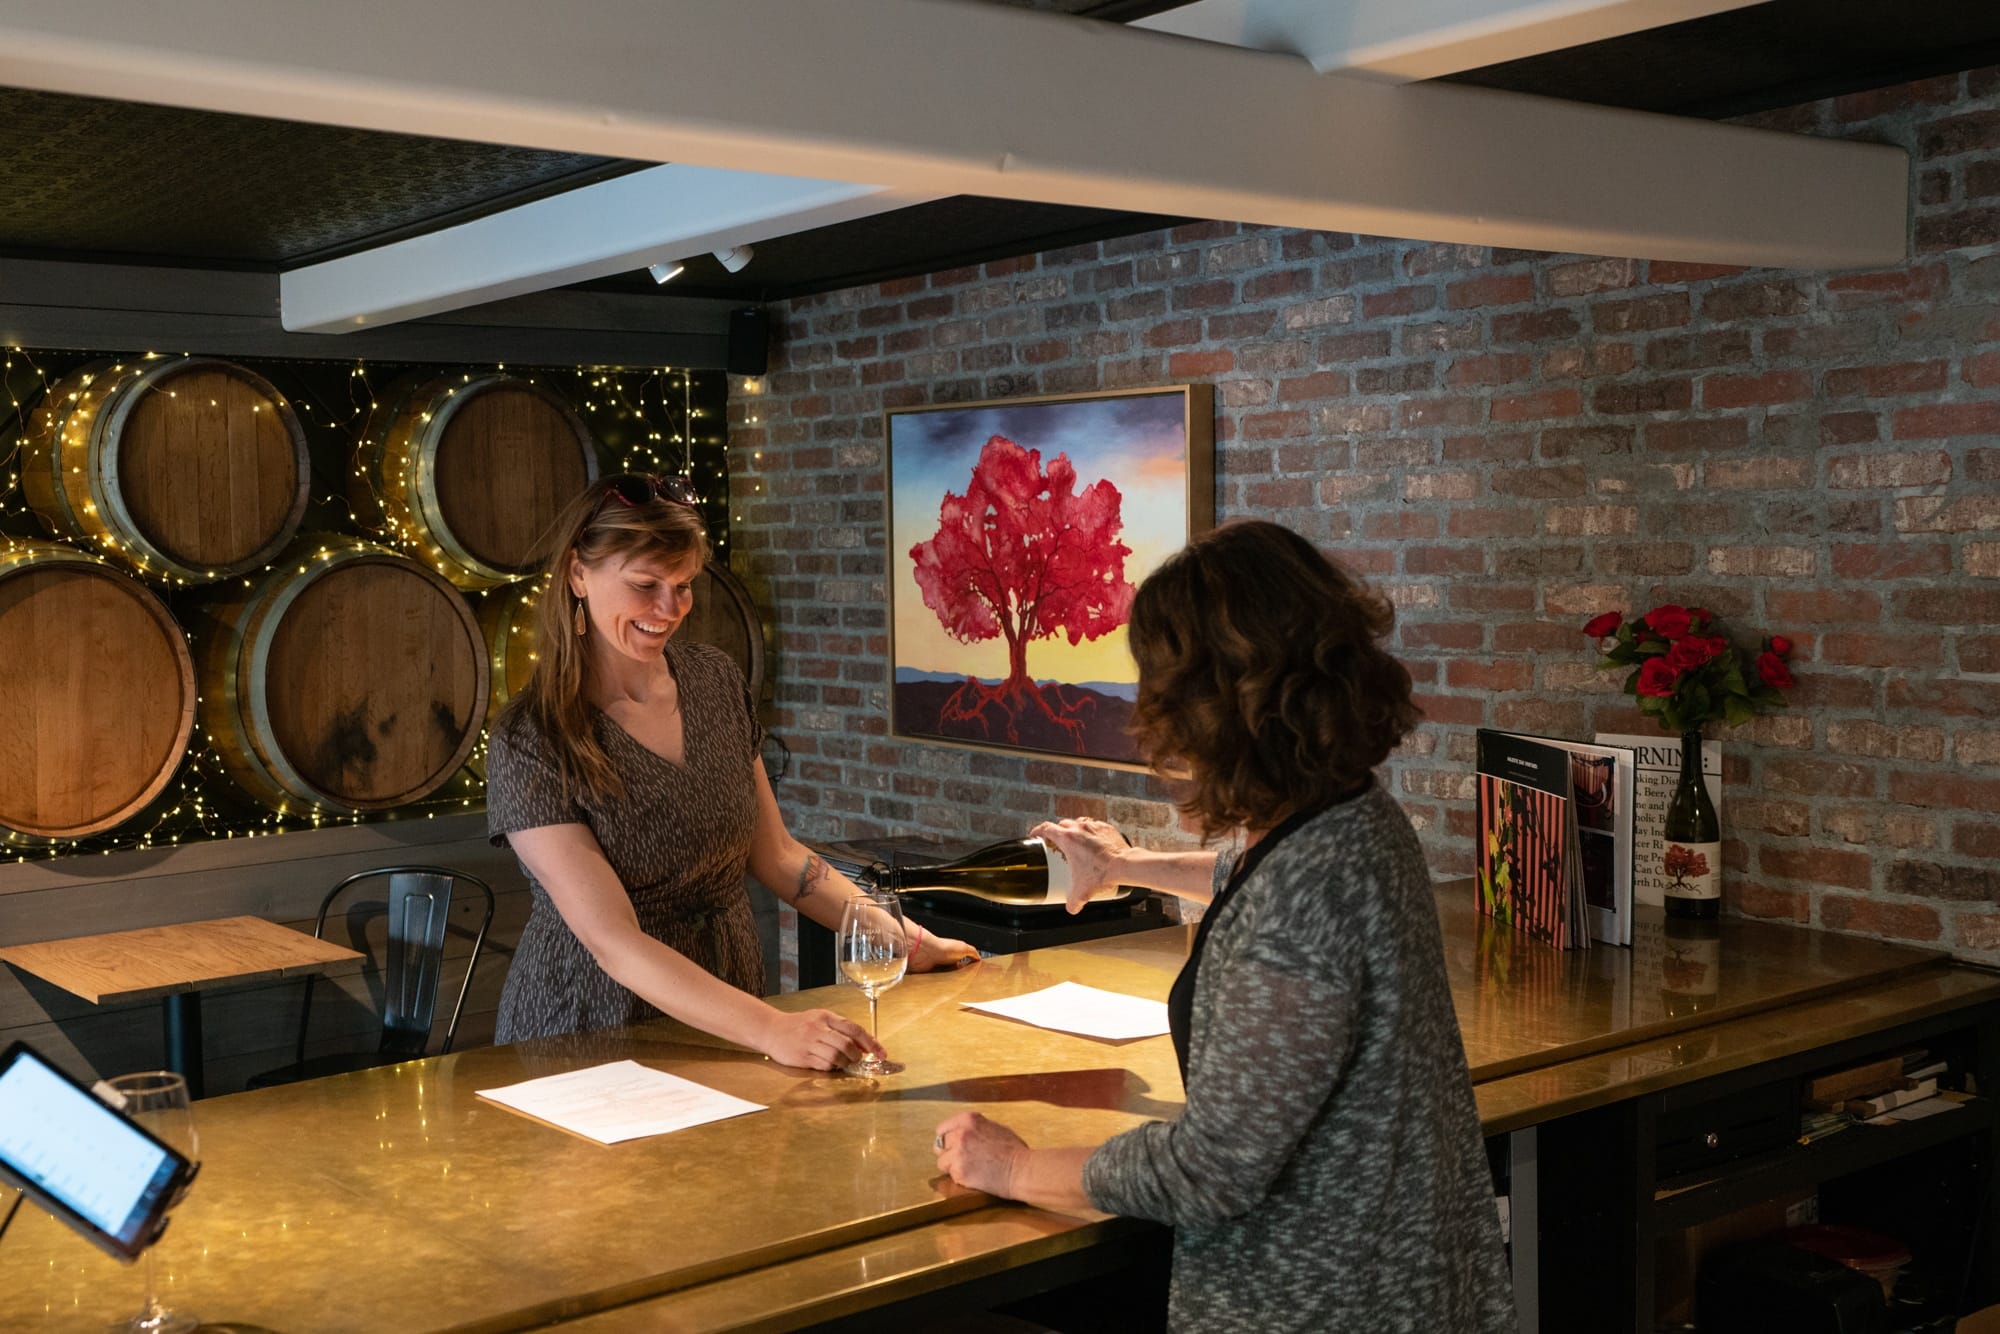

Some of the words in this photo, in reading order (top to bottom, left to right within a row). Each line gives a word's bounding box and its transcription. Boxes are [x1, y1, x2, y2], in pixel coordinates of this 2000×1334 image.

[1637, 745, 1708, 768] RNIN:
[1644, 786, 1667, 798] Beer,
[1648, 801, 1665, 810] and
[1651, 826, 1665, 836] Inc
[1652, 839, 1664, 849] Ri
[1635, 851, 1649, 862] ing
